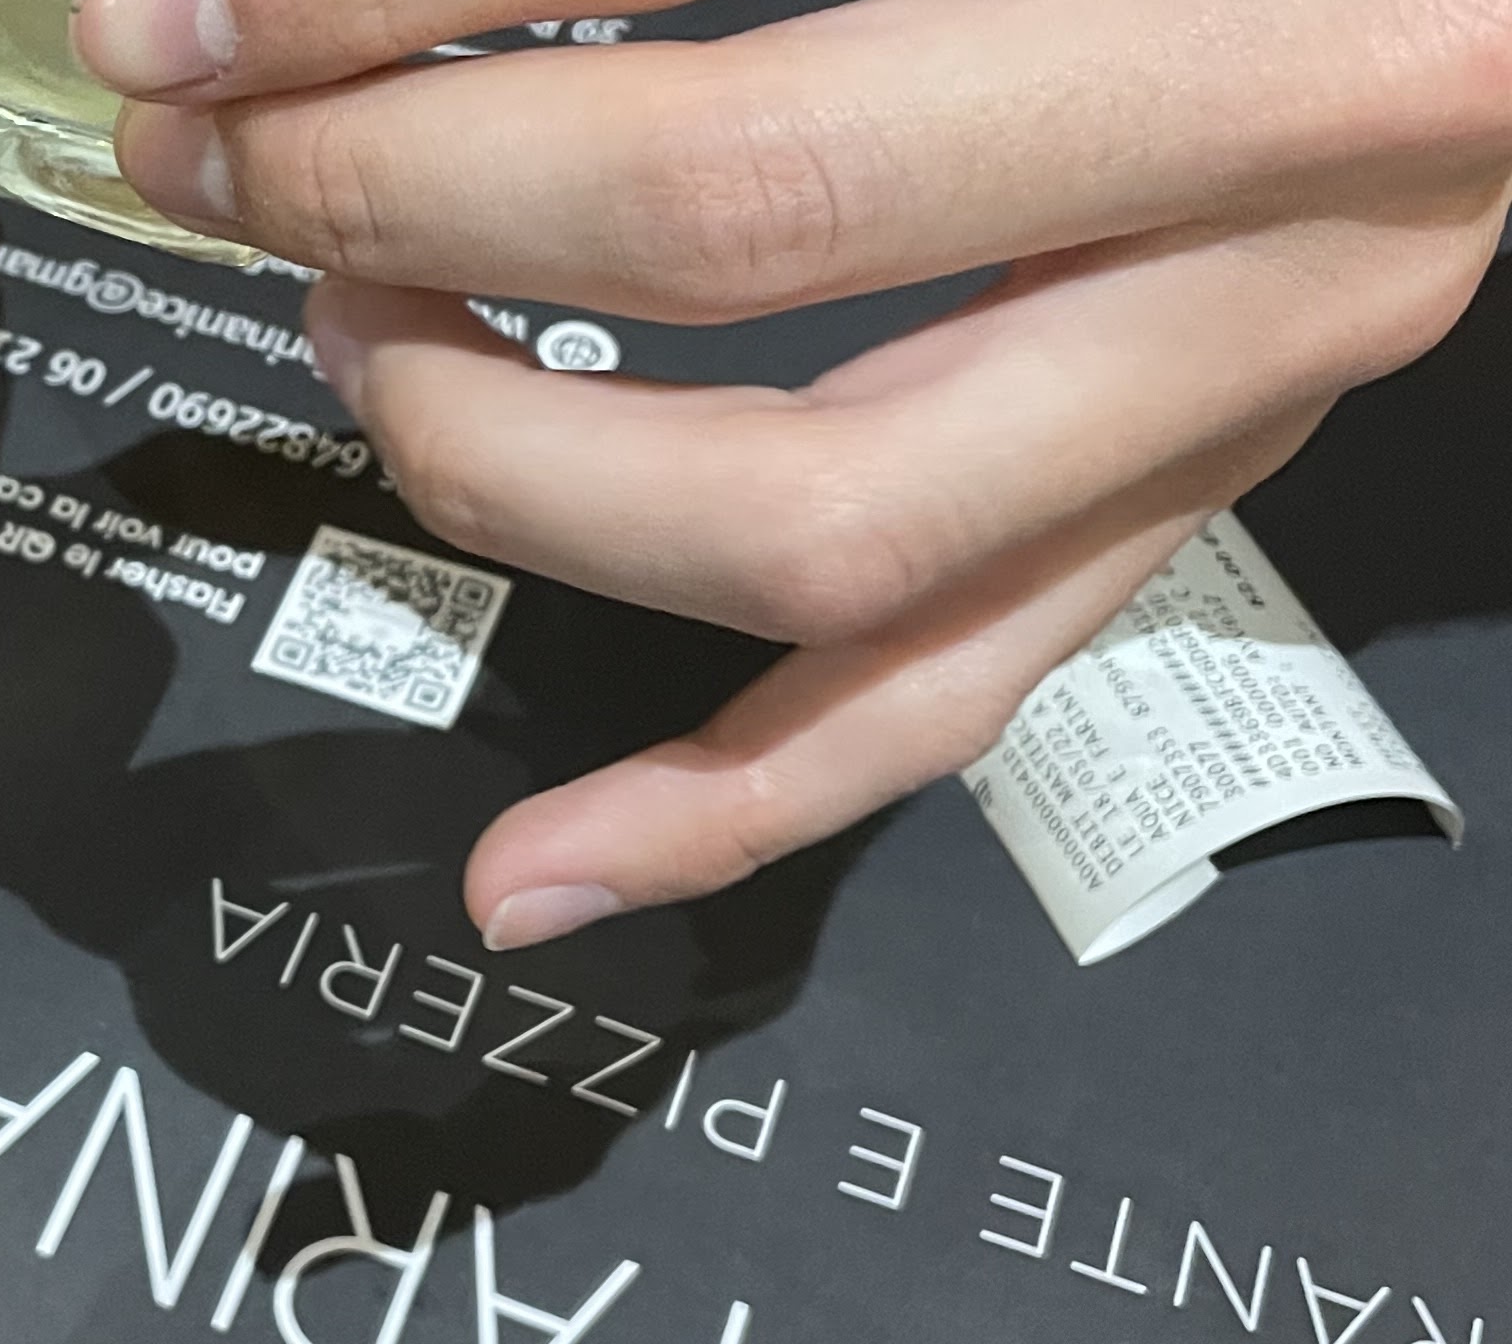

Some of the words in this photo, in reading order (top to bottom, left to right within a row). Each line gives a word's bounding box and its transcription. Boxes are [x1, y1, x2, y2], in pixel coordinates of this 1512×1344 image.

[42, 344, 109, 400] 06
[101, 366, 153, 407] /
[144, 375, 372, 481] 64822690
[45, 490, 91, 533] la
[88, 504, 167, 555] voir
[58, 538, 104, 581] le
[164, 523, 267, 584] pour
[101, 552, 247, 627] Flasher
[1049, 681, 1111, 759] FARINA
[1121, 784, 1172, 844] AQUA
[1145, 771, 1194, 830] NICE
[1070, 808, 1125, 877] DEBIT
[1115, 826, 1146, 859] LE
[206, 878, 786, 1162] PIZZERIA
[838, 1108, 923, 1210] E
